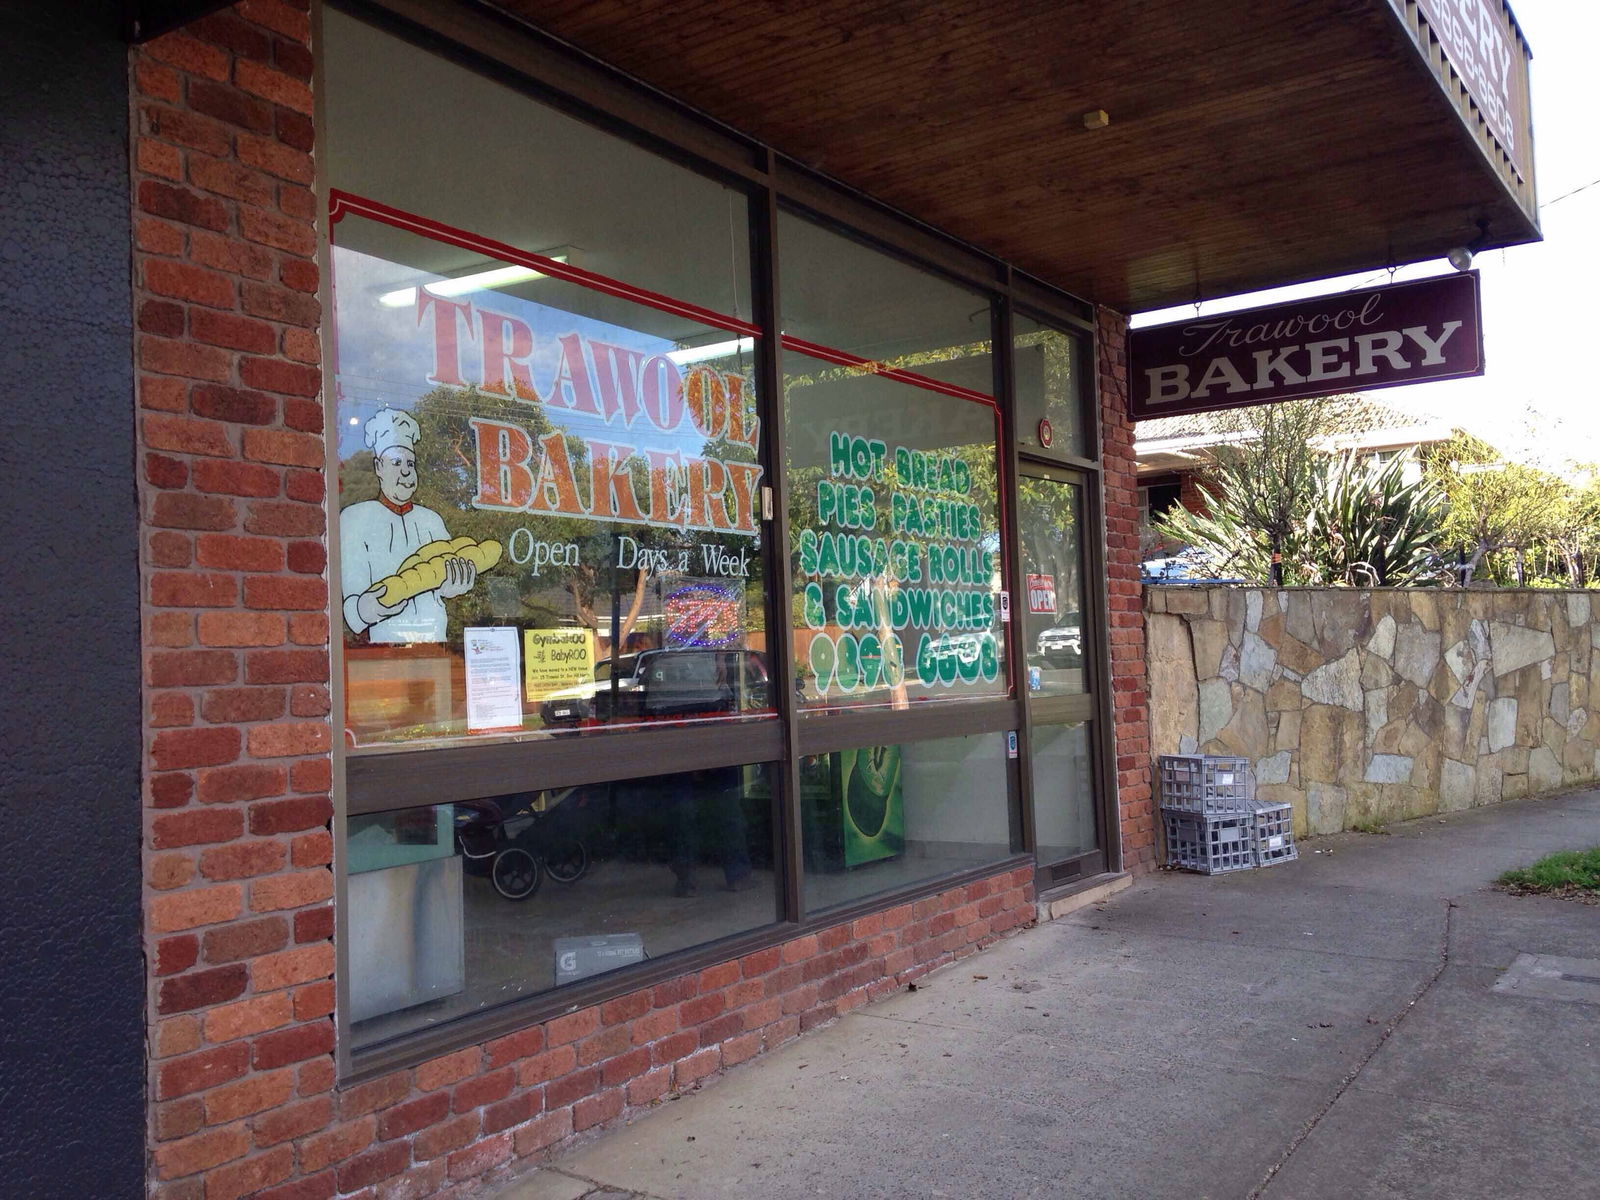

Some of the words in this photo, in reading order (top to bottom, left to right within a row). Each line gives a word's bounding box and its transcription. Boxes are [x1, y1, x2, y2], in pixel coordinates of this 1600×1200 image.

[1179, 293, 1385, 357] Trawool
[415, 286, 760, 453] TRAWOOL
[1145, 320, 1463, 405] BAKERY
[468, 417, 764, 536] BAKERY
[830, 431, 886, 483] HOT
[895, 446, 971, 496] BREAD
[818, 480, 876, 531] PIES
[892, 492, 981, 542] PASTIES
[509, 528, 580, 576] Open
[617, 536, 668, 578] Days
[676, 550, 690, 572] a
[701, 544, 751, 577] Week
[800, 528, 921, 583] SAUSAGE
[928, 543, 994, 586] ROLLS
[804, 582, 826, 630] &
[835, 584, 995, 631] SANDWICHES
[1030, 589, 1056, 609] OPEN
[551, 649, 587, 663] BabyROO
